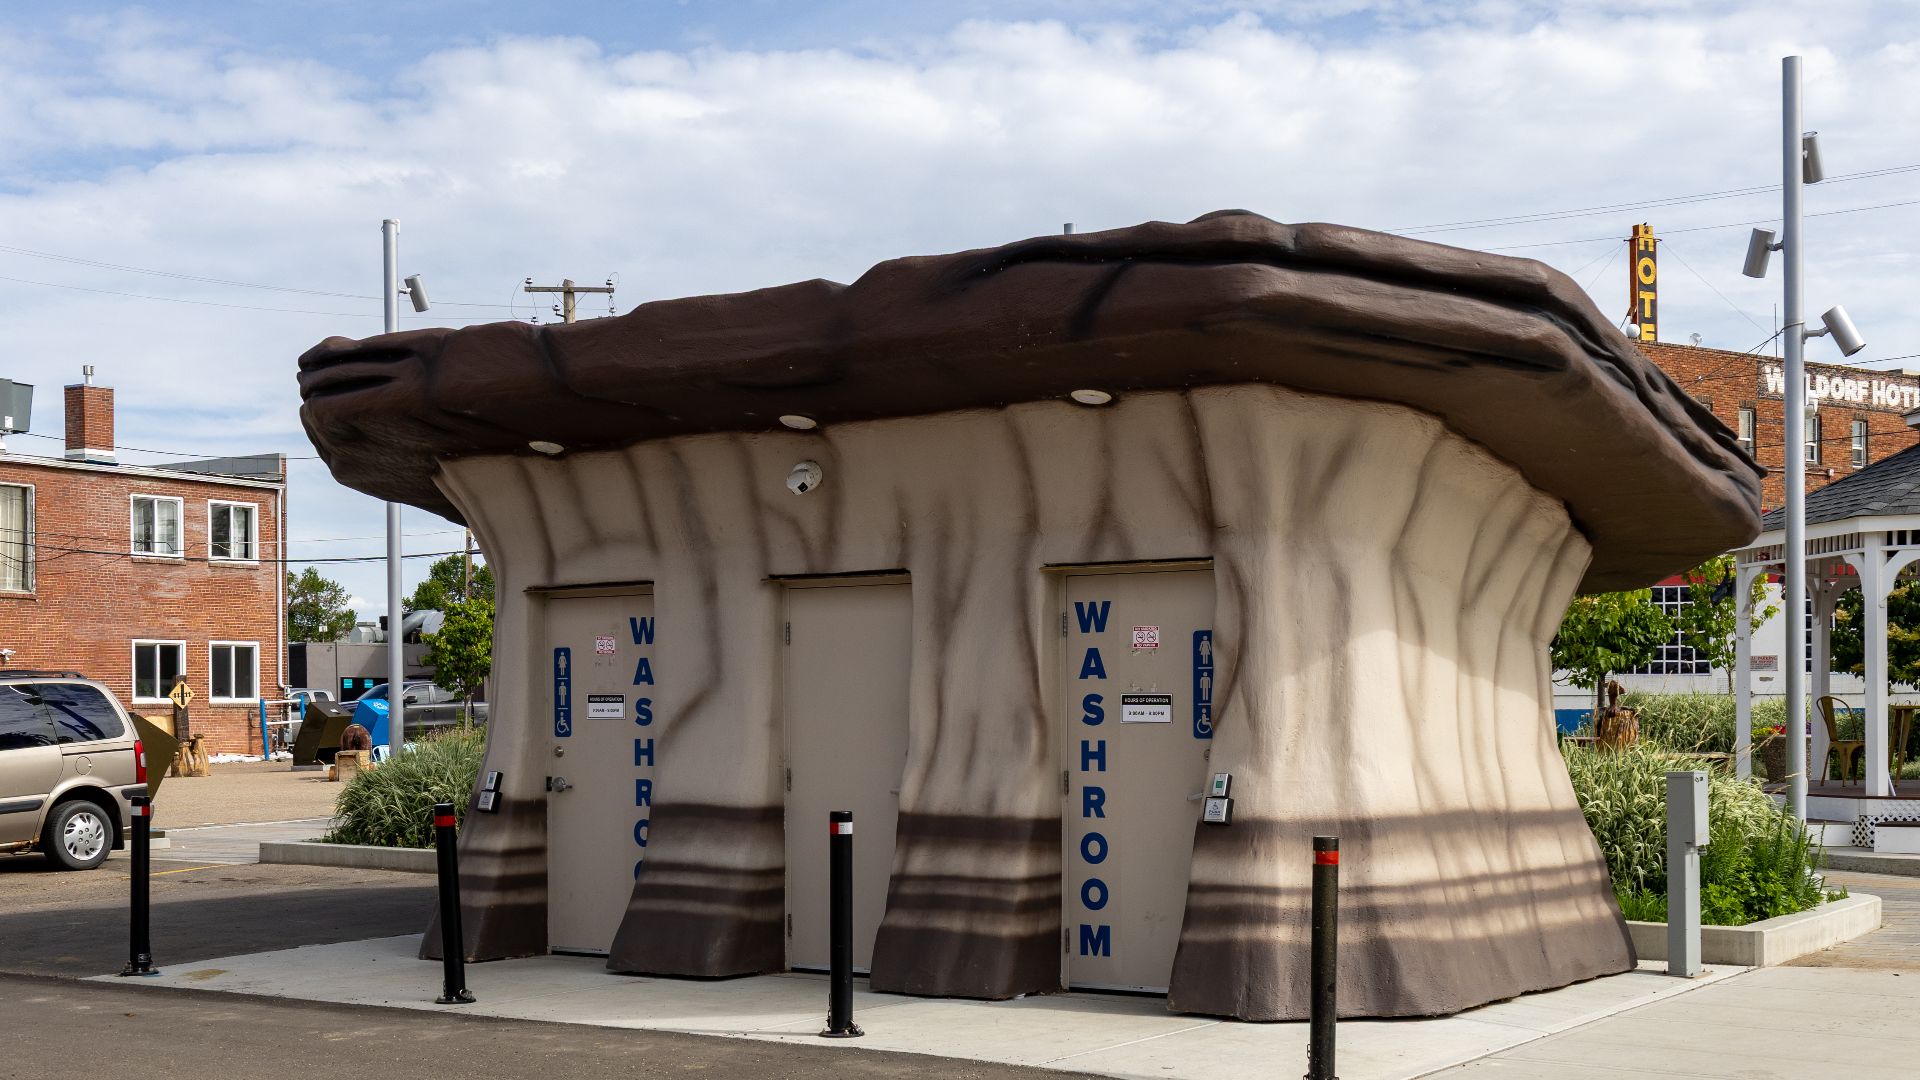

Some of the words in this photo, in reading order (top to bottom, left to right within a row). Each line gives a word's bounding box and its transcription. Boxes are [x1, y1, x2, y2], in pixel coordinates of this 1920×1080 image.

[1638, 224, 1656, 341] HOTE
[1764, 364, 1869, 402] WLDORF
[630, 617, 654, 881] WASHRO
[1074, 601, 1111, 957] WASHROOM
